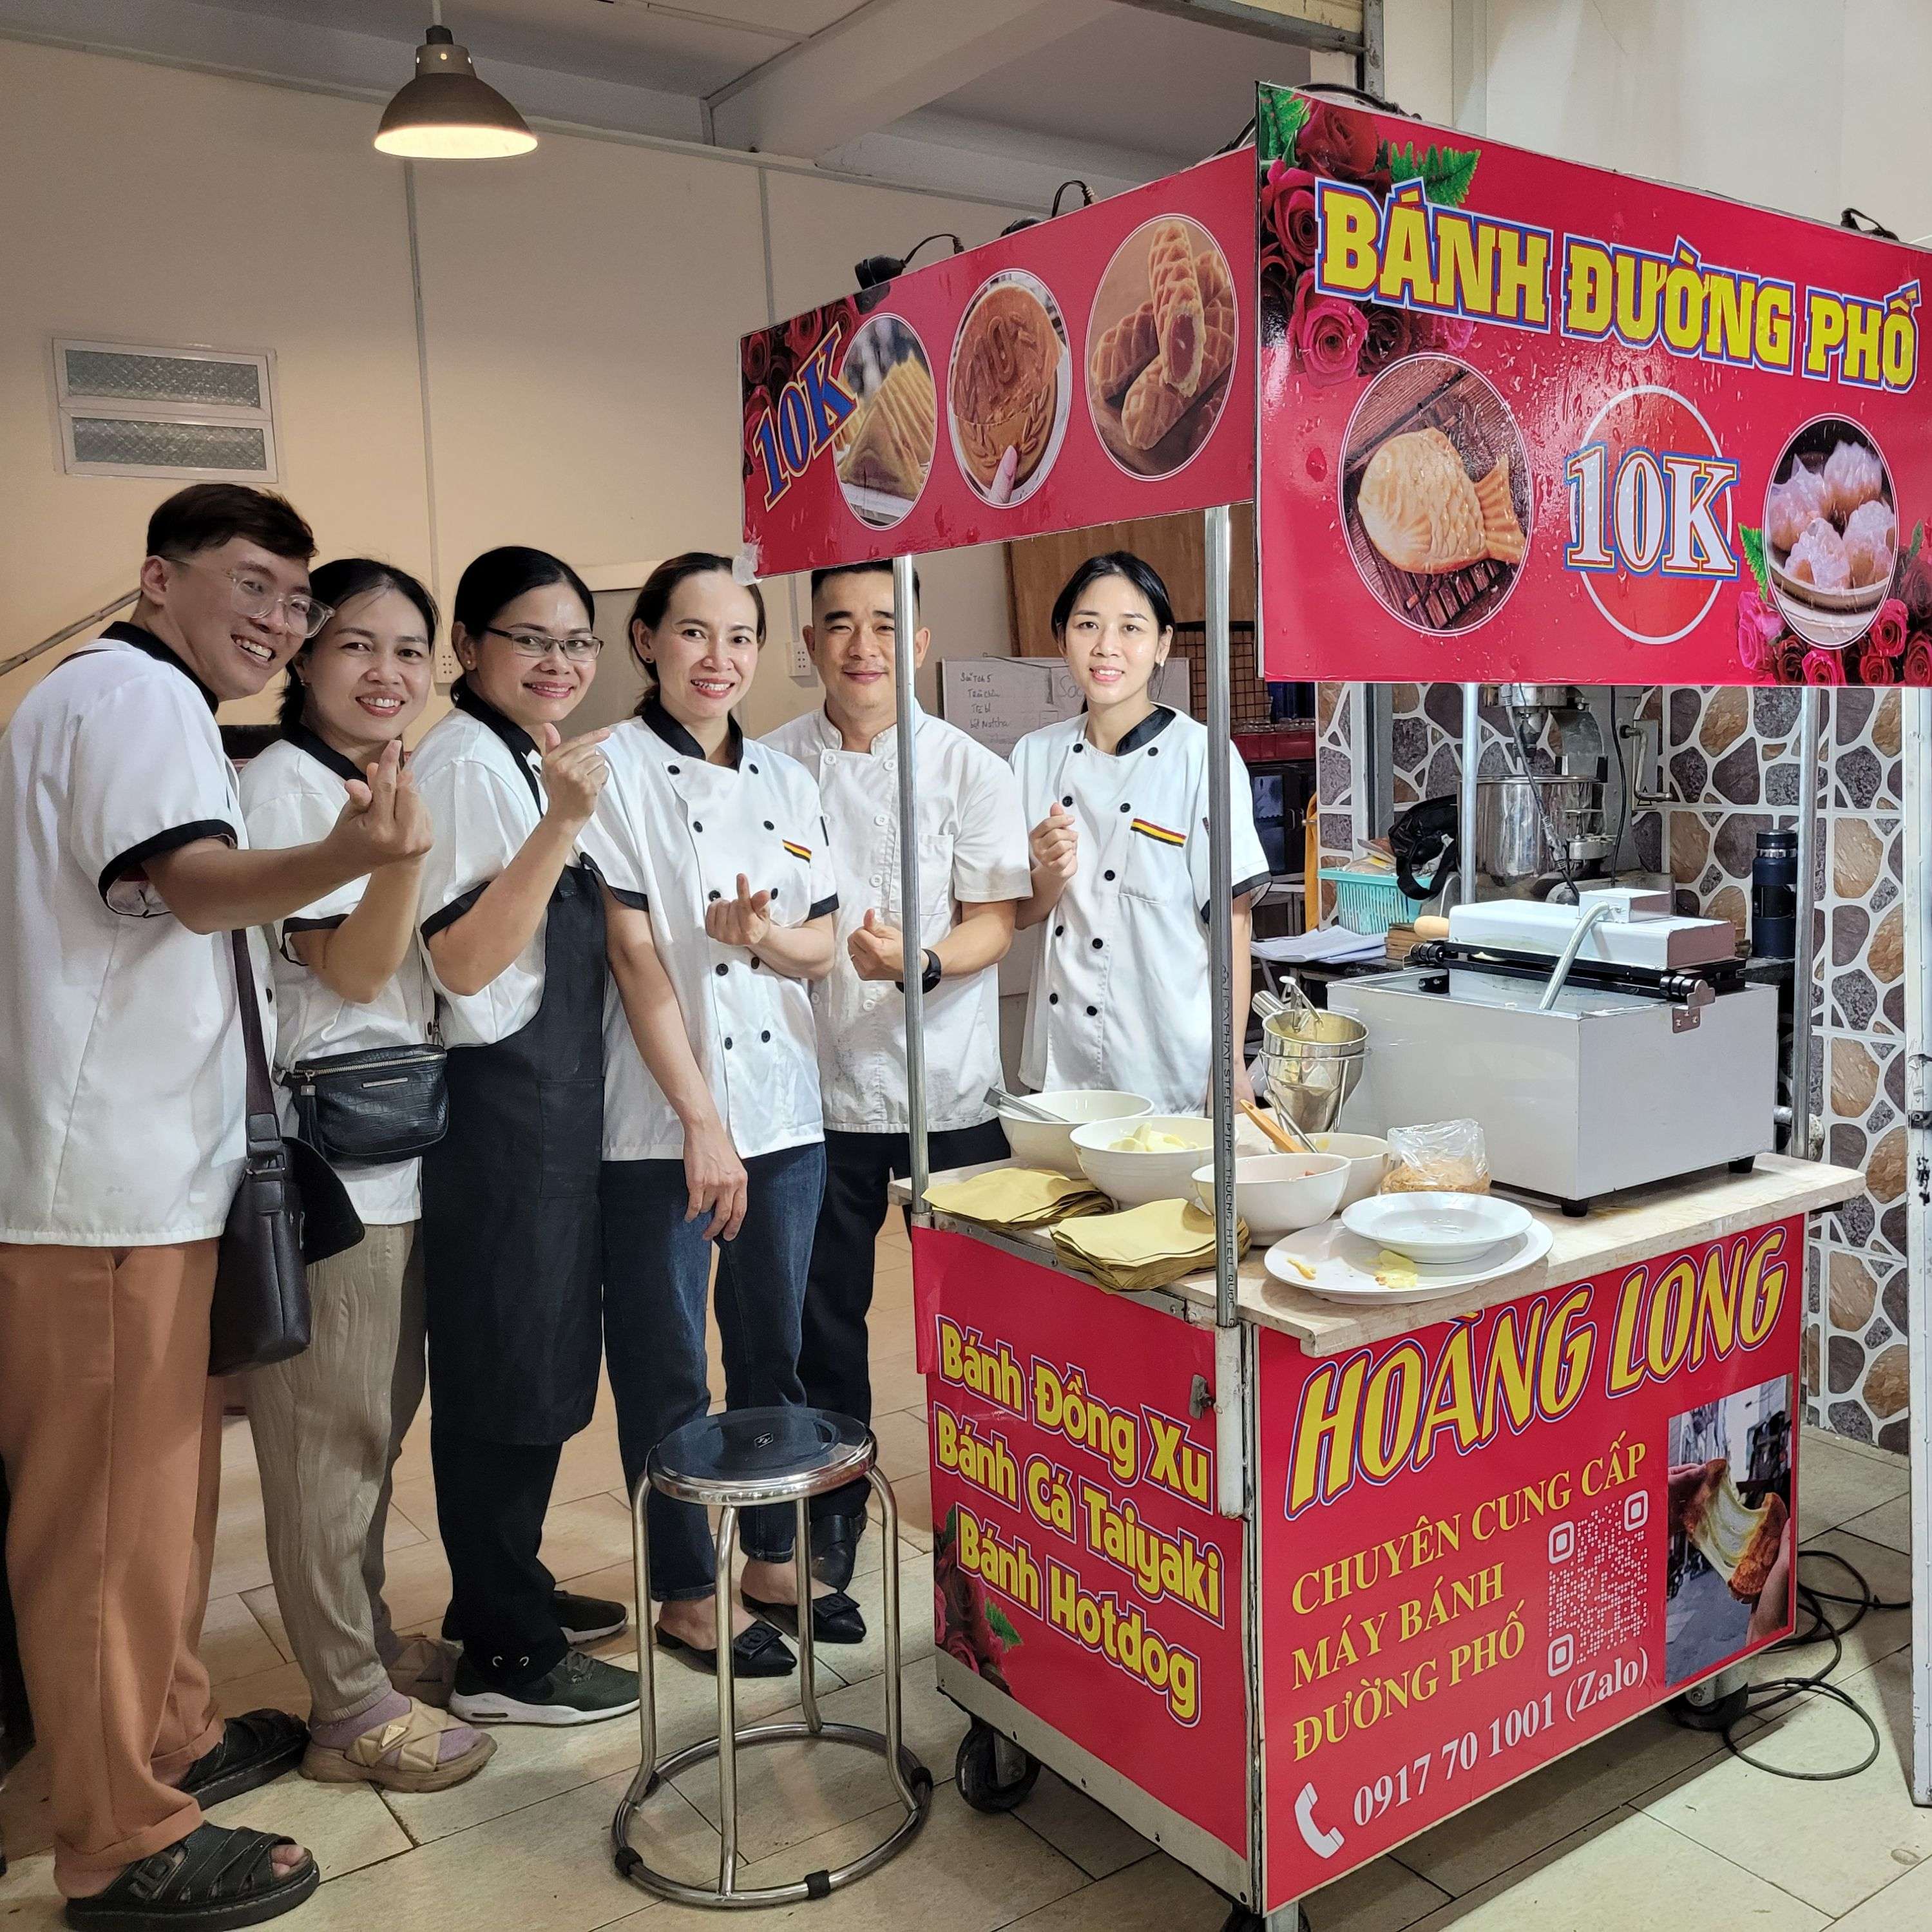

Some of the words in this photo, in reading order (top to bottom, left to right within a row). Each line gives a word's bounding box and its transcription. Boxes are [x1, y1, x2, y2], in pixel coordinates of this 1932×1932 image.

[1318, 182, 1550, 330] BÁNH
[1564, 241, 1793, 371] ĐƯỜNG
[1805, 283, 1918, 390] PHỐ
[754, 323, 859, 511] 10K
[1565, 442, 1739, 579] 10K
[1225, 1169, 1234, 1221] THUONG
[1227, 1274, 1236, 1309] QUOC
[1287, 1286, 1596, 1517] HOÀNG
[1608, 1228, 1787, 1395] LONG
[938, 1317, 1025, 1417] Bánh
[1032, 1359, 1138, 1484] Đồng
[1144, 1408, 1212, 1509] Xu
[936, 1405, 1019, 1508] Bánh
[1026, 1457, 1075, 1539] Cá
[1081, 1480, 1223, 1625] Taiyaki
[1292, 1515, 1462, 1614] CHUYÊN
[1471, 1469, 1572, 1541] CUNG
[1580, 1430, 1647, 1497] CẤP
[957, 1506, 1042, 1616] Bánh
[1047, 1560, 1199, 1724] Hotdog
[1292, 1612, 1388, 1690] MÁY
[1397, 1562, 1506, 1643] BÁNH
[1292, 1658, 1440, 1762] ĐƯỜNG
[1448, 1599, 1526, 1687] PHỐ
[1353, 1752, 1431, 1826] 0917
[1440, 1731, 1478, 1781] 70
[1488, 1691, 1554, 1758] 1001
[1565, 1647, 1649, 1721] (Zalo)
